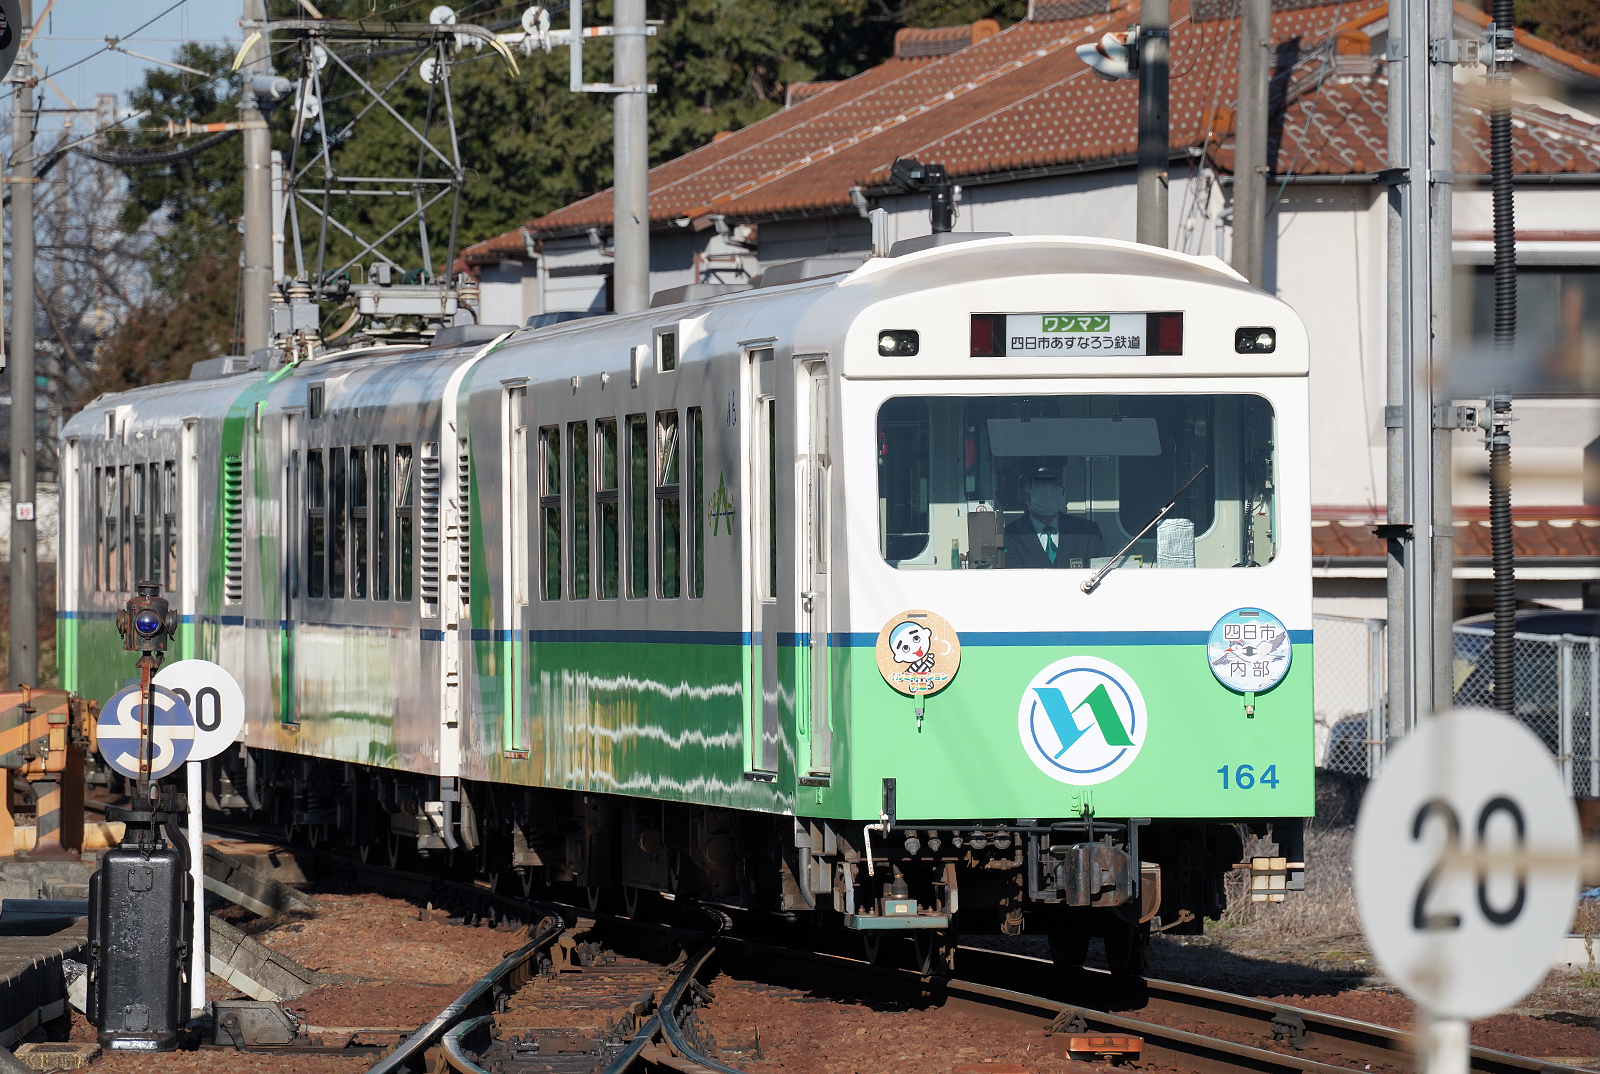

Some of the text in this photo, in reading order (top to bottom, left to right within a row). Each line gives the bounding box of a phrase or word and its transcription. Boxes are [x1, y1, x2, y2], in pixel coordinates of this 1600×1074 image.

[1044, 317, 1109, 332] ワンマン
[1011, 336, 1141, 350] 四日市あすなろう鉄道
[1224, 624, 1276, 640] 四日市
[1230, 661, 1270, 677] 内部
[1217, 765, 1279, 789] 164
[1411, 797, 1526, 928] 20
